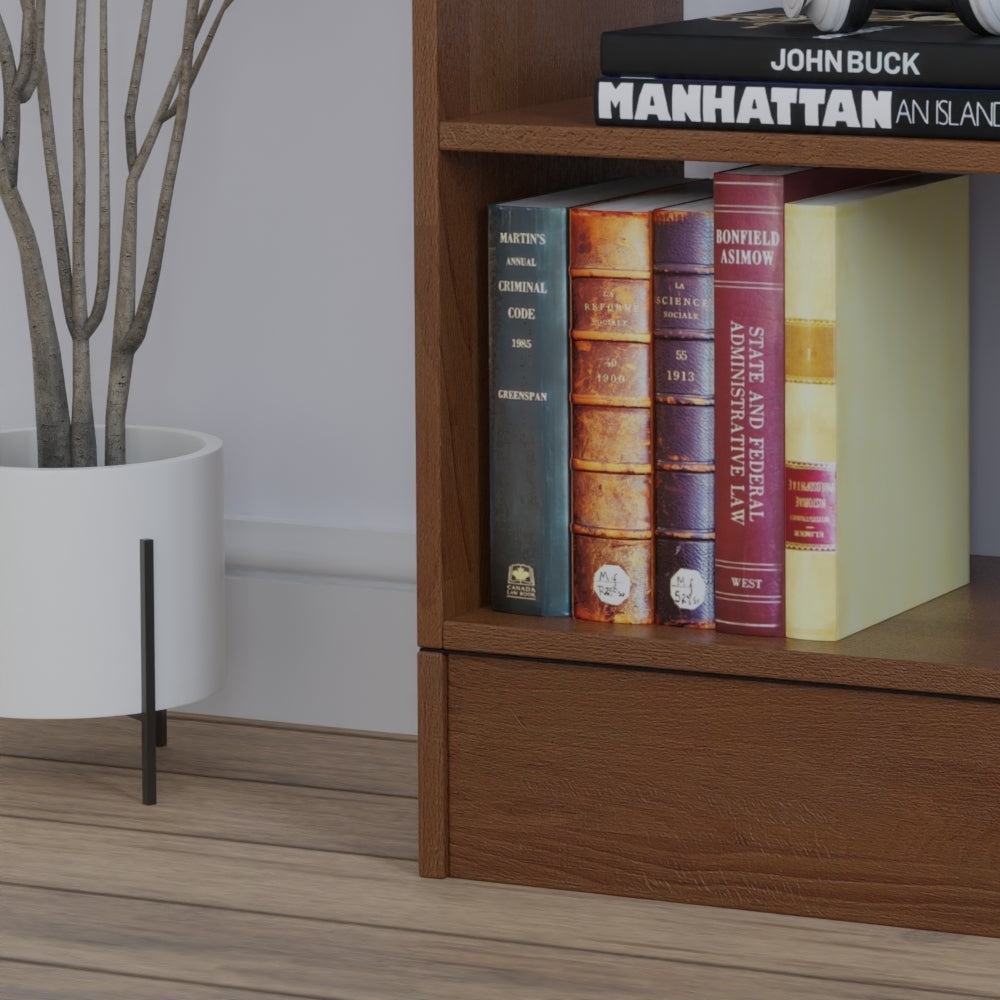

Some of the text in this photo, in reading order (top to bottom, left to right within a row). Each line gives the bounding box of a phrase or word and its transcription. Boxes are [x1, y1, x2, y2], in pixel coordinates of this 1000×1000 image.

[770, 48, 920, 76] JOHN BUCK
[598, 81, 893, 129] MANHATTAN
[896, 99, 929, 125] AN
[500, 232, 546, 245] MARTIN'S
[716, 229, 780, 247] BONFIELD
[506, 257, 536, 267] ANNUAL
[720, 249, 774, 266] ASIMOW
[499, 280, 547, 294] CRIMINAL
[674, 282, 685, 290] LA
[507, 306, 535, 320] CODE
[511, 338, 532, 348] 1985
[675, 350, 688, 361] 55
[666, 371, 695, 382] 1913
[498, 389, 547, 401] GREENSPAN
[730, 320, 745, 526] ADMINISTRATIVE LAW
[749, 326, 764, 522] STATE AND FEDERAL
[506, 585, 536, 593] CANADA
[731, 577, 762, 589] WEST
